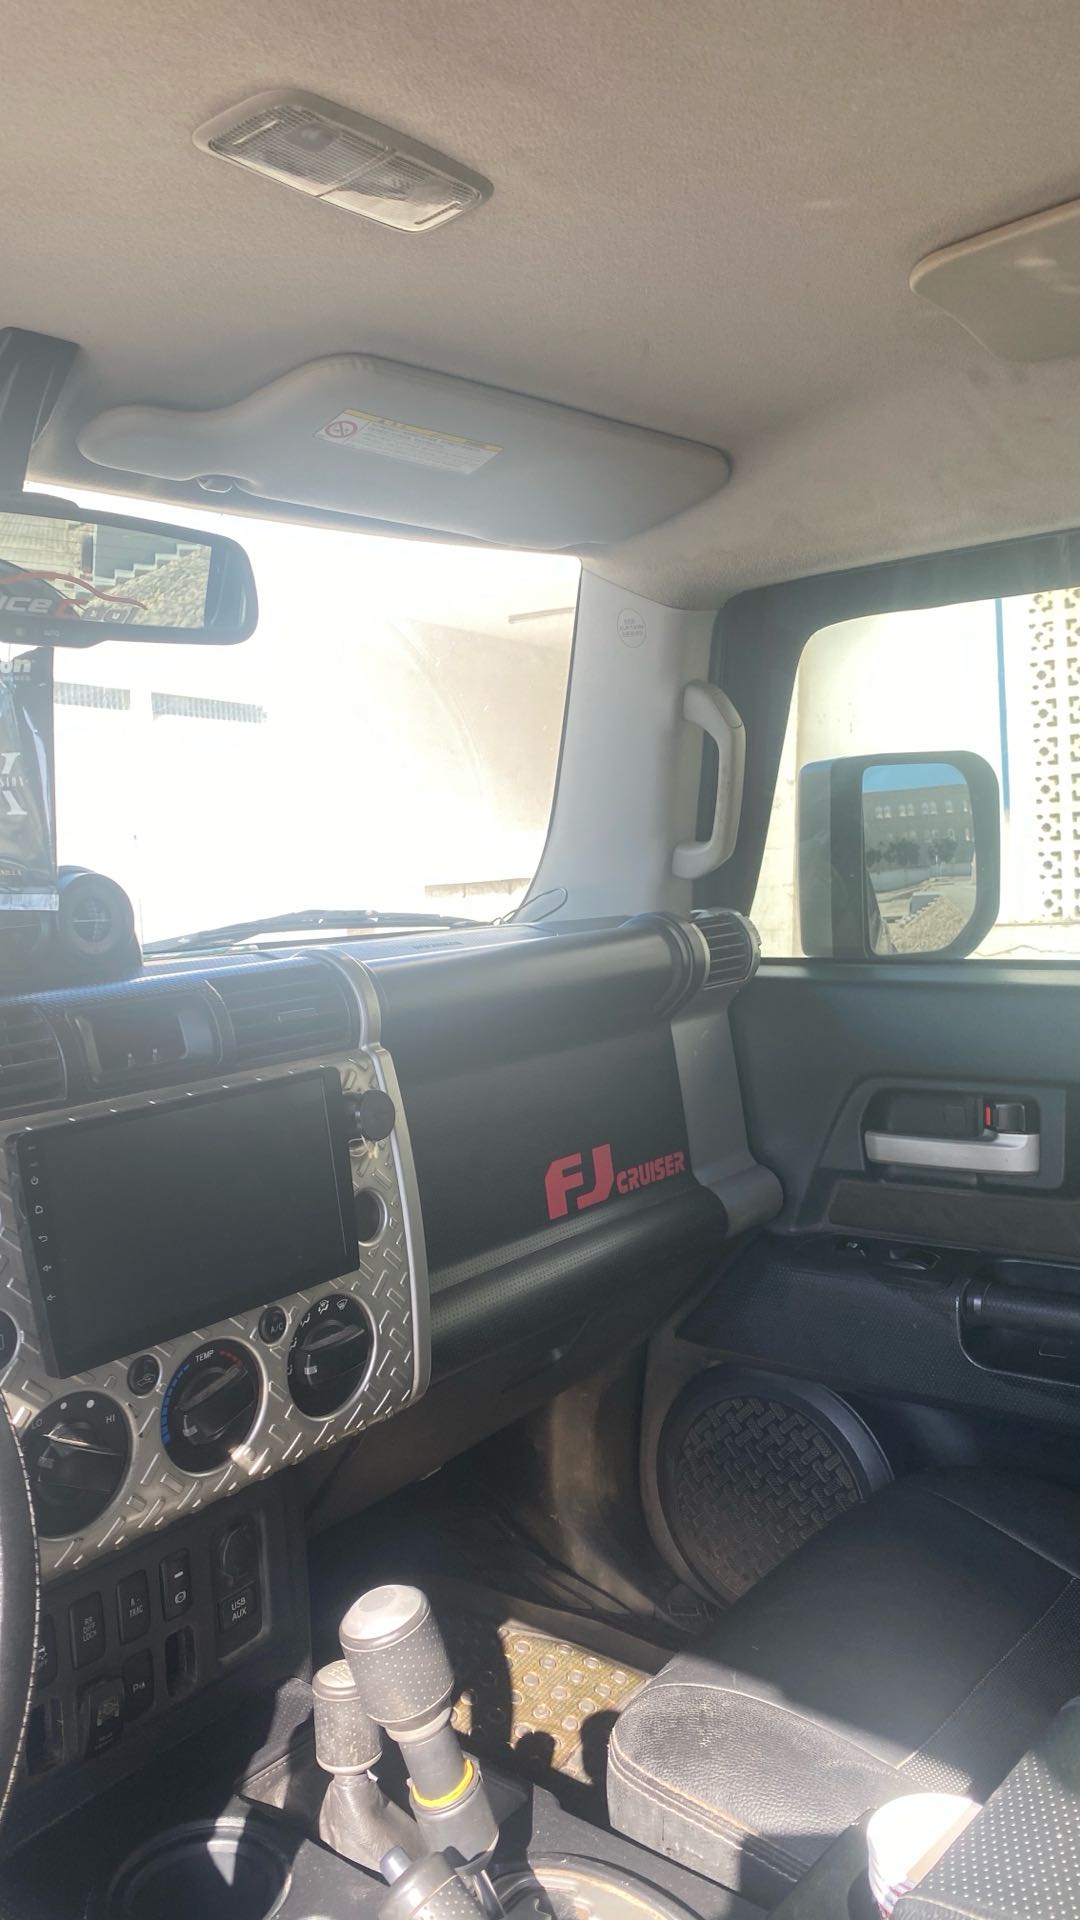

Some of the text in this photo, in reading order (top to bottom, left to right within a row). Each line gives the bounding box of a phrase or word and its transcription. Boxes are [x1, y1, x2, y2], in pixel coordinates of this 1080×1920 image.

[544, 1143, 686, 1220] FJ CRUISER
[270, 1321, 286, 1334] A/C
[195, 1349, 215, 1363] TEMP
[105, 1415, 116, 1425] HI
[231, 1597, 246, 1611] USB
[231, 1607, 247, 1621] AUX
